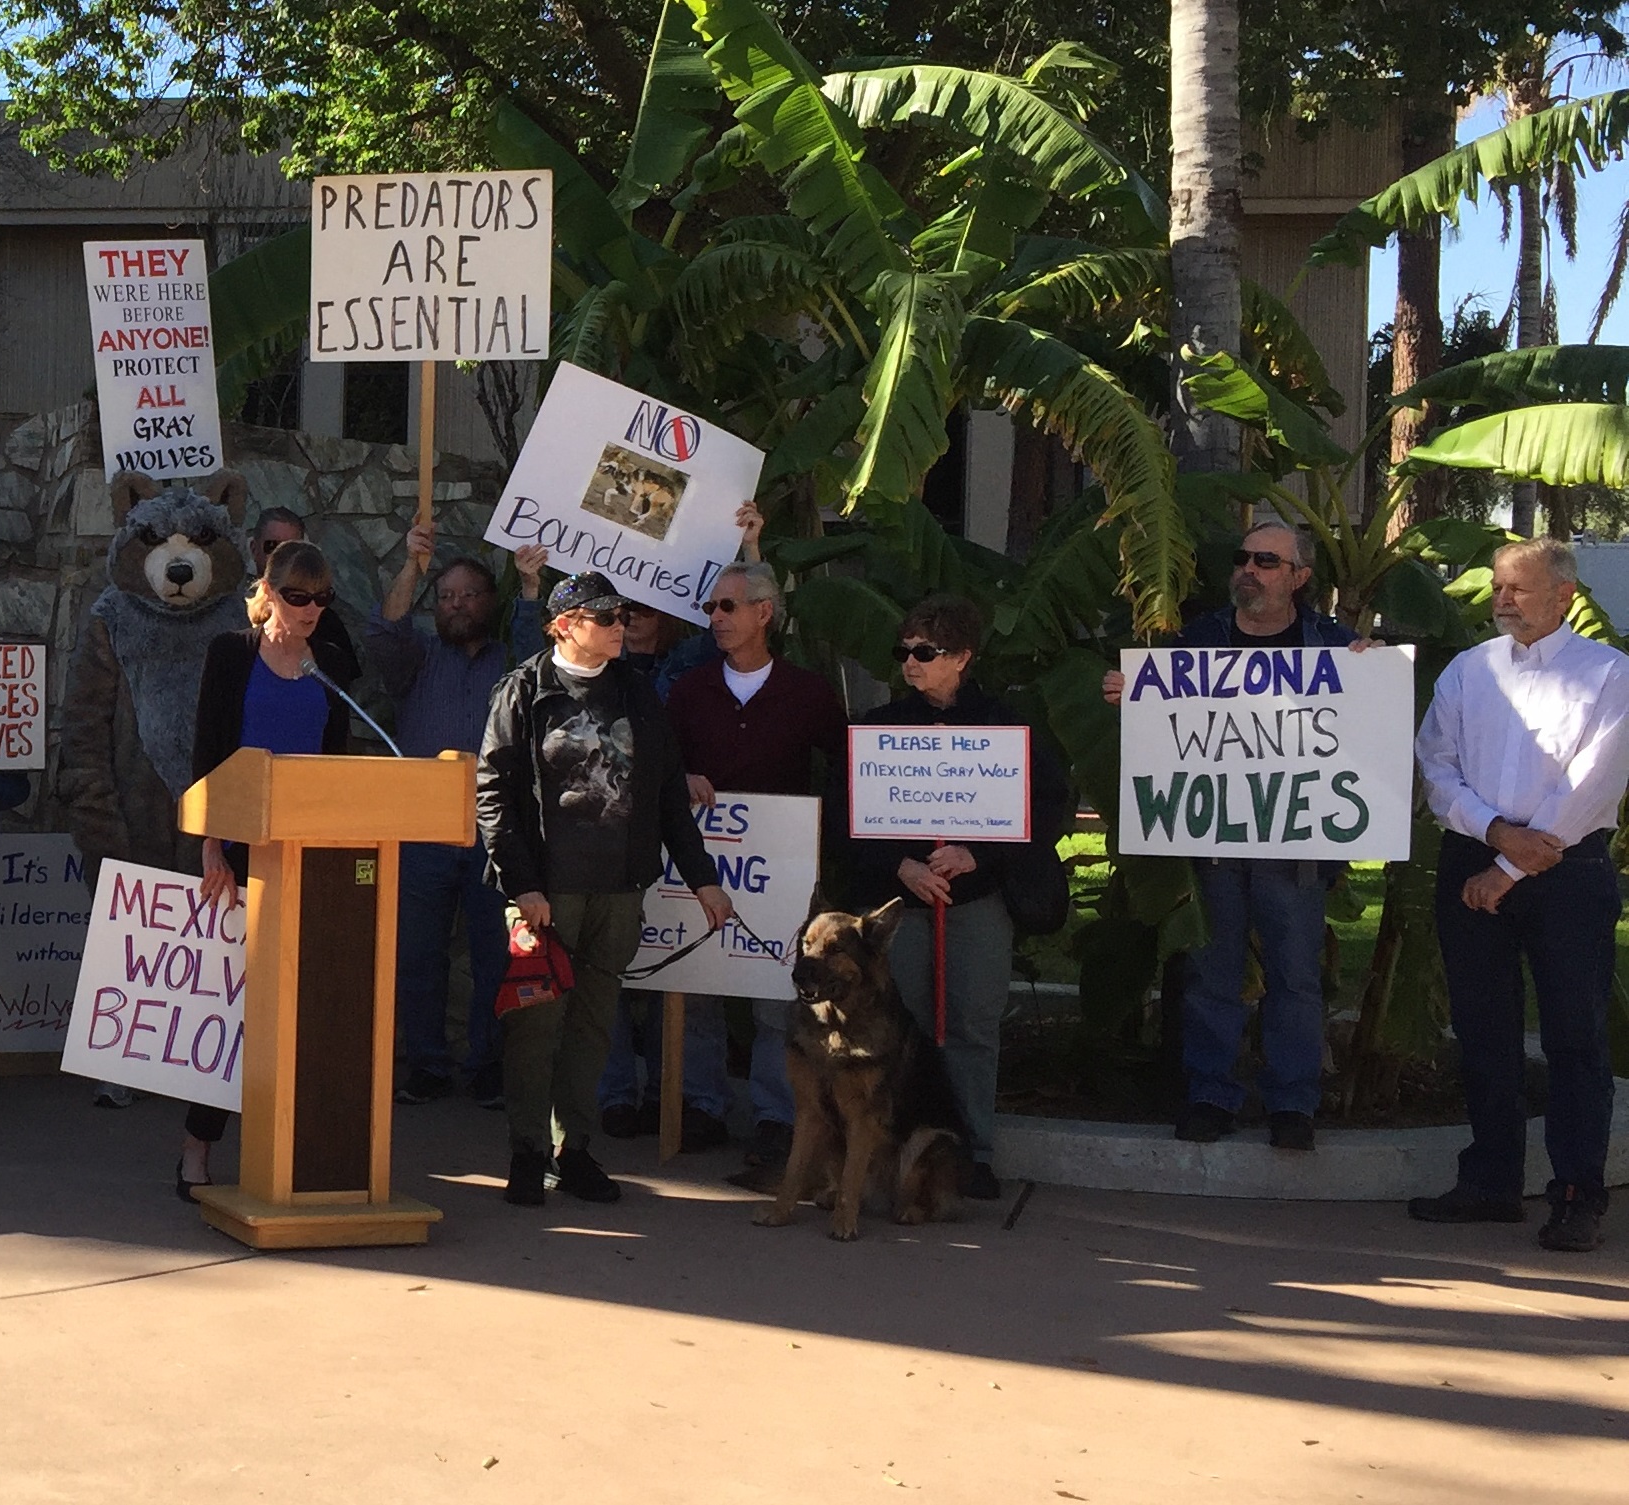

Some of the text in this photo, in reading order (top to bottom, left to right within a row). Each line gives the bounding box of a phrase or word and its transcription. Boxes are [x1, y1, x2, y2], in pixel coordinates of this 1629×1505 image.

[321, 177, 541, 231] PREDATORS
[99, 249, 189, 278] THEY
[382, 235, 481, 287] ARE
[94, 283, 206, 303] WERE HERE
[123, 306, 184, 323] BEFORE
[317, 295, 540, 354] ESSENTIAL
[97, 326, 209, 352] ANYONE!
[113, 356, 200, 377] PROTECT
[136, 385, 186, 410] ALL
[133, 414, 195, 442] GRAY
[624, 400, 701, 461] NO
[116, 445, 215, 472] WOLVES
[1130, 650, 1343, 701] ARIZONA
[878, 734, 990, 751] PLEASE HELP
[1168, 707, 1339, 761] WANTS
[860, 762, 1018, 777] MEXICAN GRAY WOLF
[889, 786, 977, 803] RECOVERY
[1132, 770, 1369, 844] WOLVES
[3, 853, 48, 884] It's
